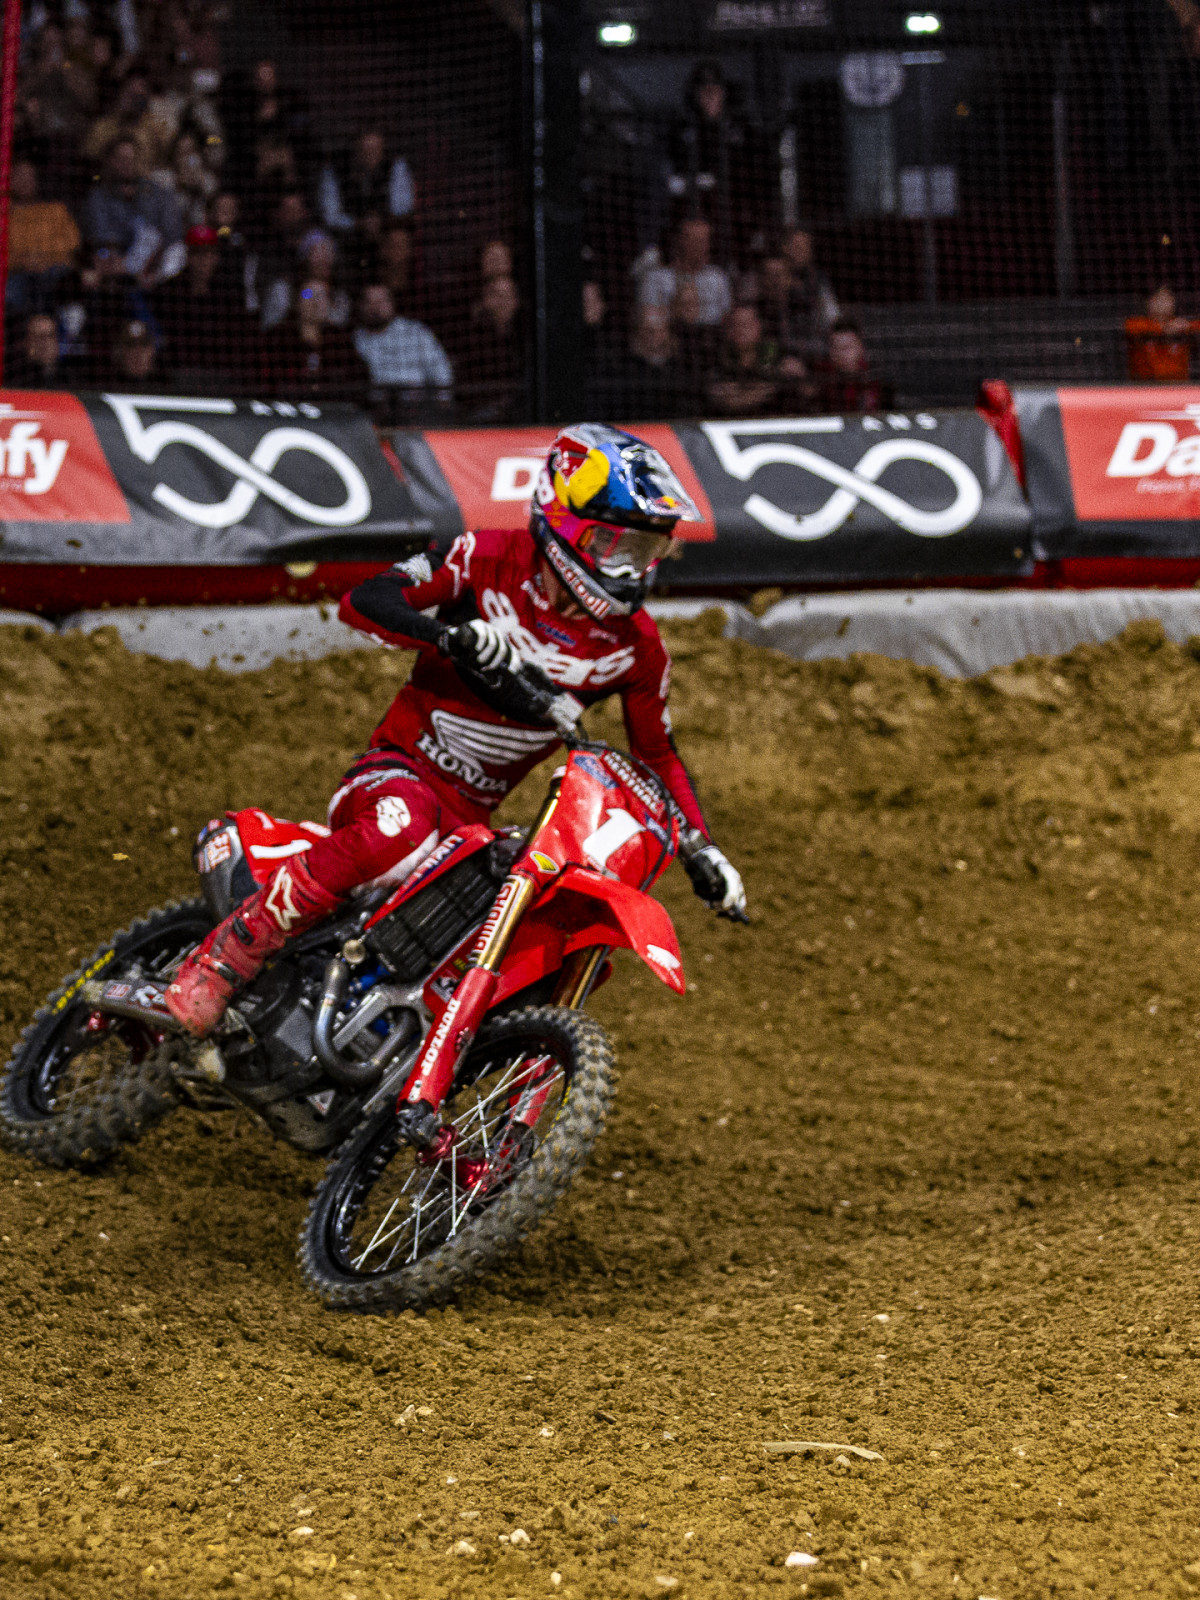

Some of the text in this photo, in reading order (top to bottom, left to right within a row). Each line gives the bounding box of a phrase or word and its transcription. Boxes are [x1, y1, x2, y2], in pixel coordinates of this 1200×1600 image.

[102, 392, 373, 528] 50
[701, 416, 984, 541] 50
[415, 732, 508, 793] HONDA
[583, 807, 647, 871] 1
[422, 998, 461, 1076] DUNLOP
